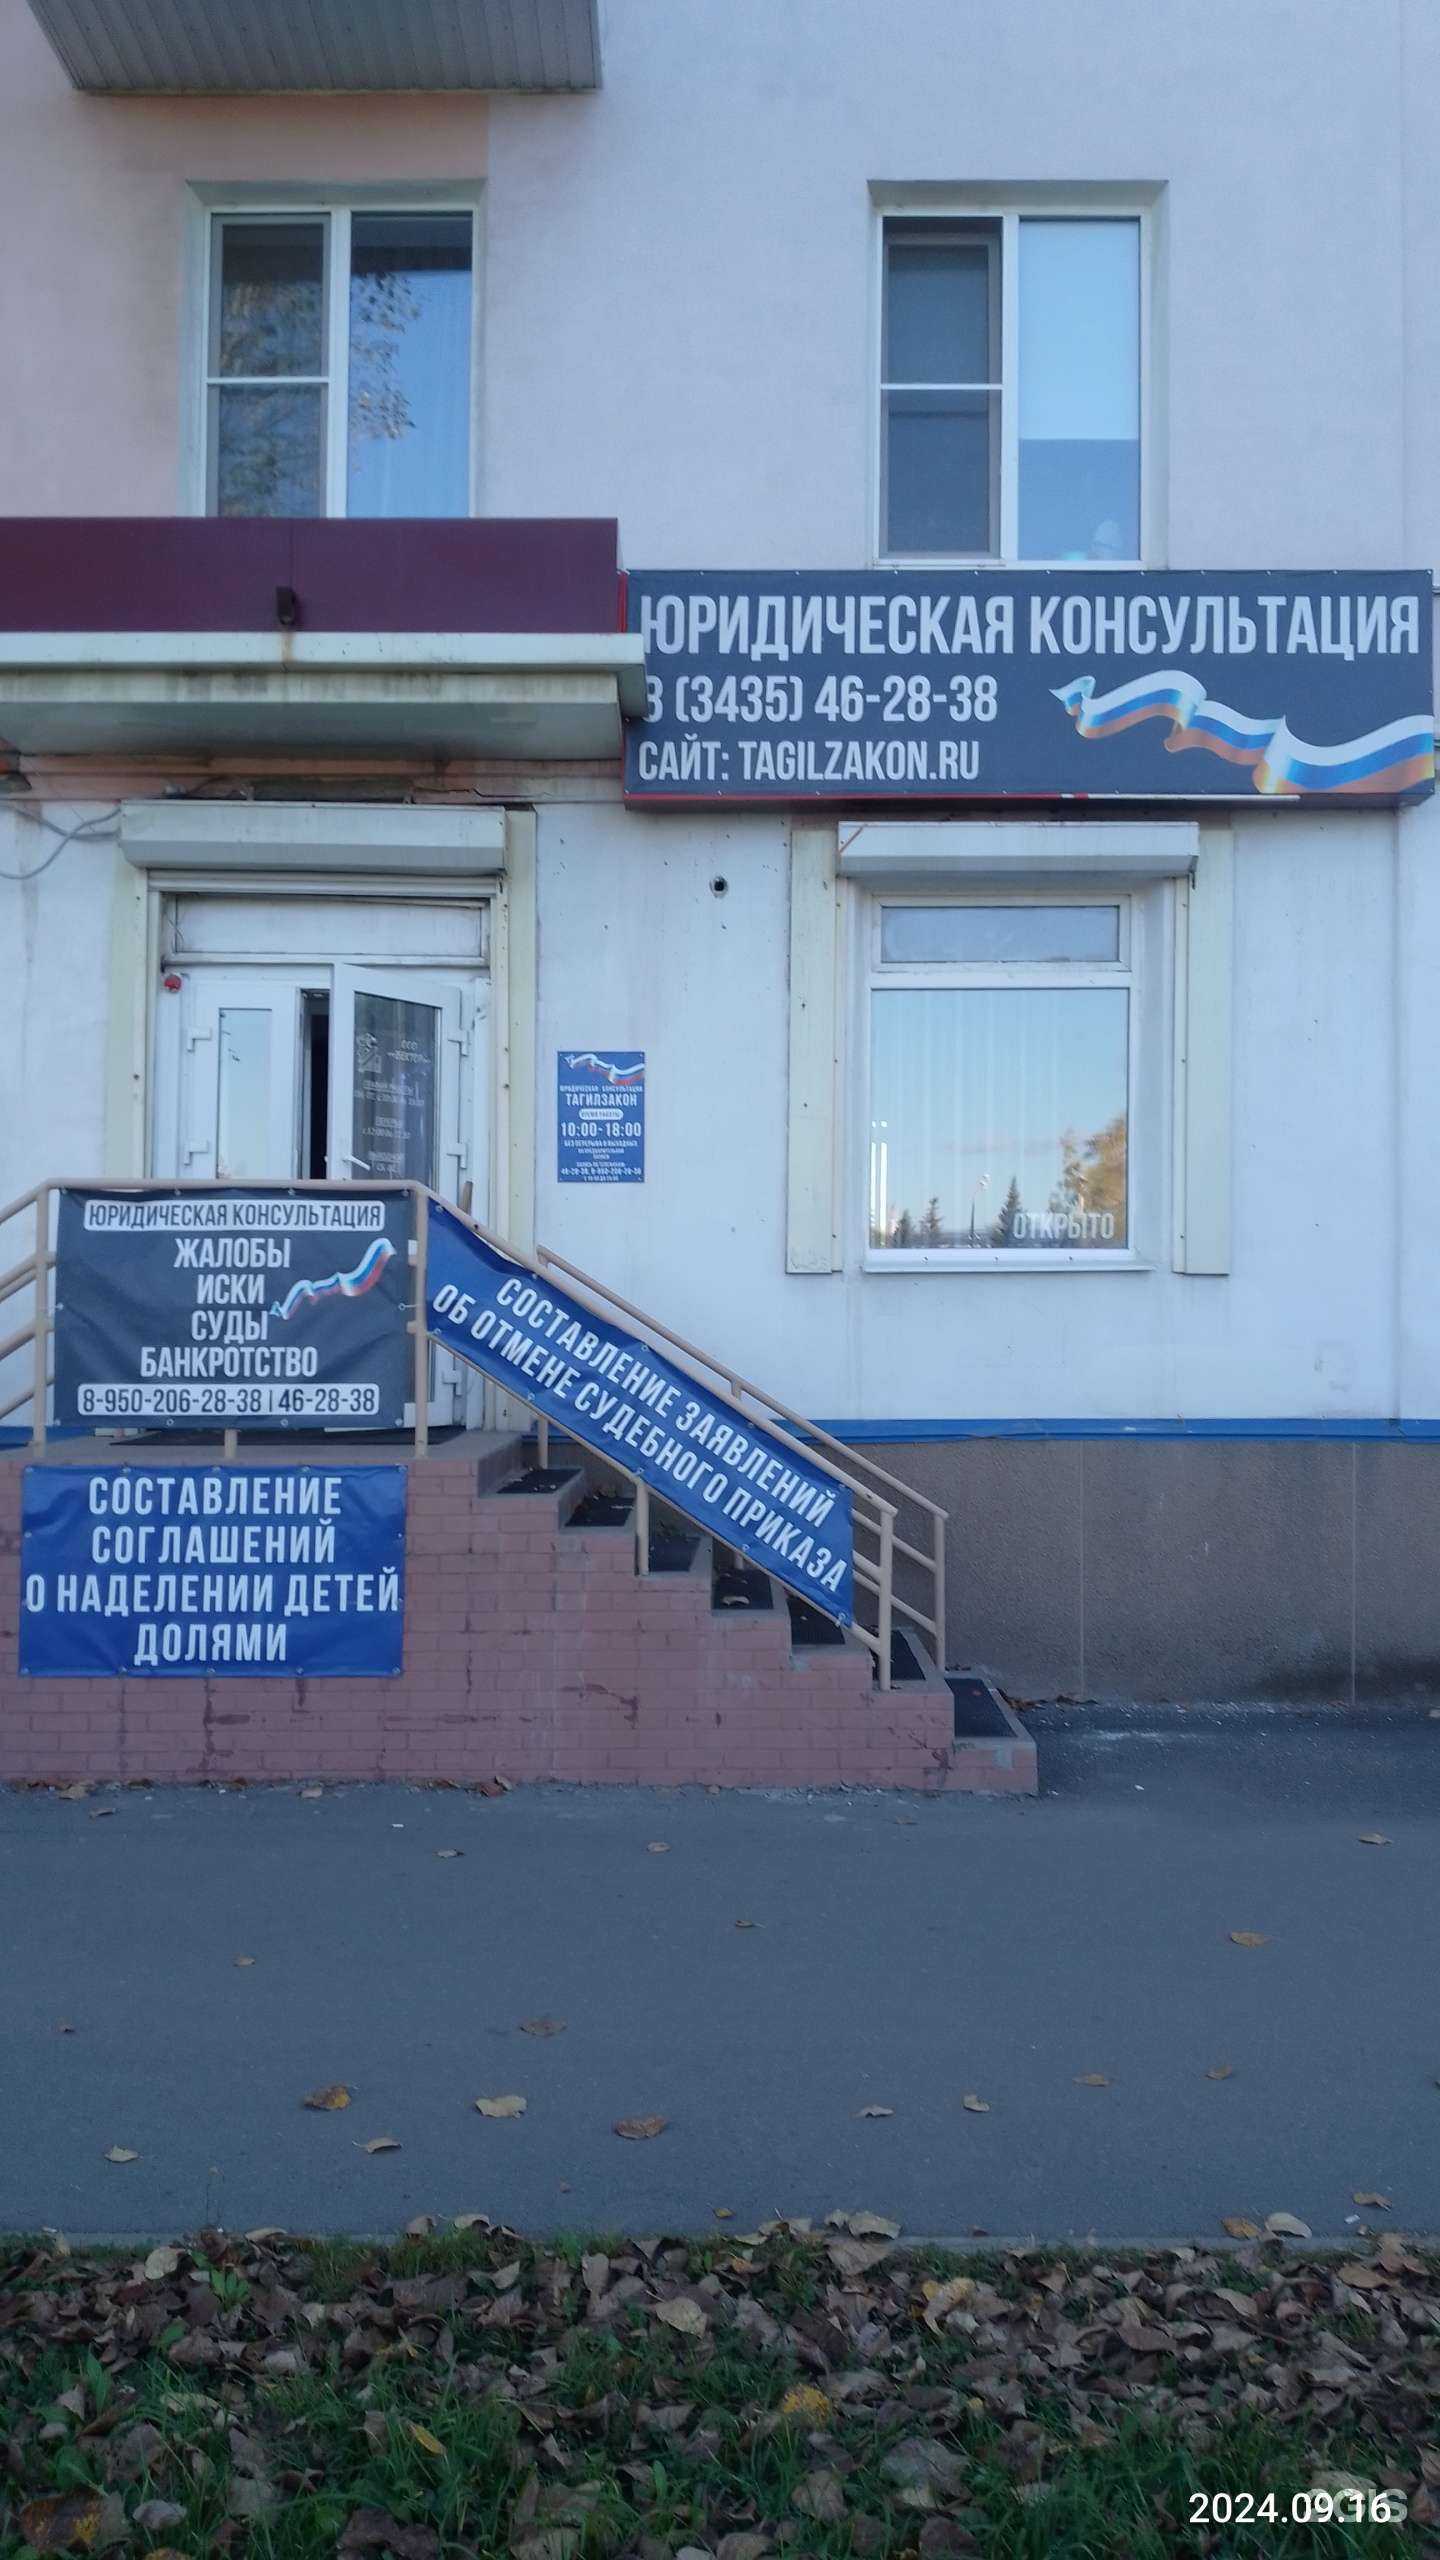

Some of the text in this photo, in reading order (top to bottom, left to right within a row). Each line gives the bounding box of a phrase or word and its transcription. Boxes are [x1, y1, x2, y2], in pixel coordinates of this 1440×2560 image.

[641, 595, 1419, 661] ЮРИДИЧЕСКАЯ КОНСУЛЬТАЦИЯ
[676, 674, 803, 723] (3435)
[815, 674, 998, 723] 46-28-38
[639, 733, 981, 781] САЙТ: TAGILZAKON.RU
[89, 1203, 381, 1229] ЮРИДИЧЕСКАЯ КОНСУЛЬТАЦИЯ
[1013, 1211, 1115, 1240] ОТКРЫТО
[174, 1237, 291, 1269] ЖАЛОБЫ
[197, 1274, 265, 1305] ИСКИ
[191, 1310, 268, 1344] СУДЫ
[141, 1346, 318, 1378] БАНКРОТСТВО
[83, 1388, 375, 1414] 8-950-206-28-38 46-28-38
[496, 1278, 835, 1528] СОСТАВЛЕНИЕ ЗАЯВЛЕНИЙ
[432, 1283, 848, 1592] ОБ ОТМЕНЕ СУДЕБНОГО ПРИКАЗА
[89, 1476, 342, 1516] СОСТАВЛЕНИЕ
[92, 1517, 336, 1564] СОГЛАШЕНИЙ
[26, 1566, 399, 1617] О НАДЕЛЕНИИ ДЕТЕЙ
[134, 1622, 287, 1667] ДОЛЯМИ
